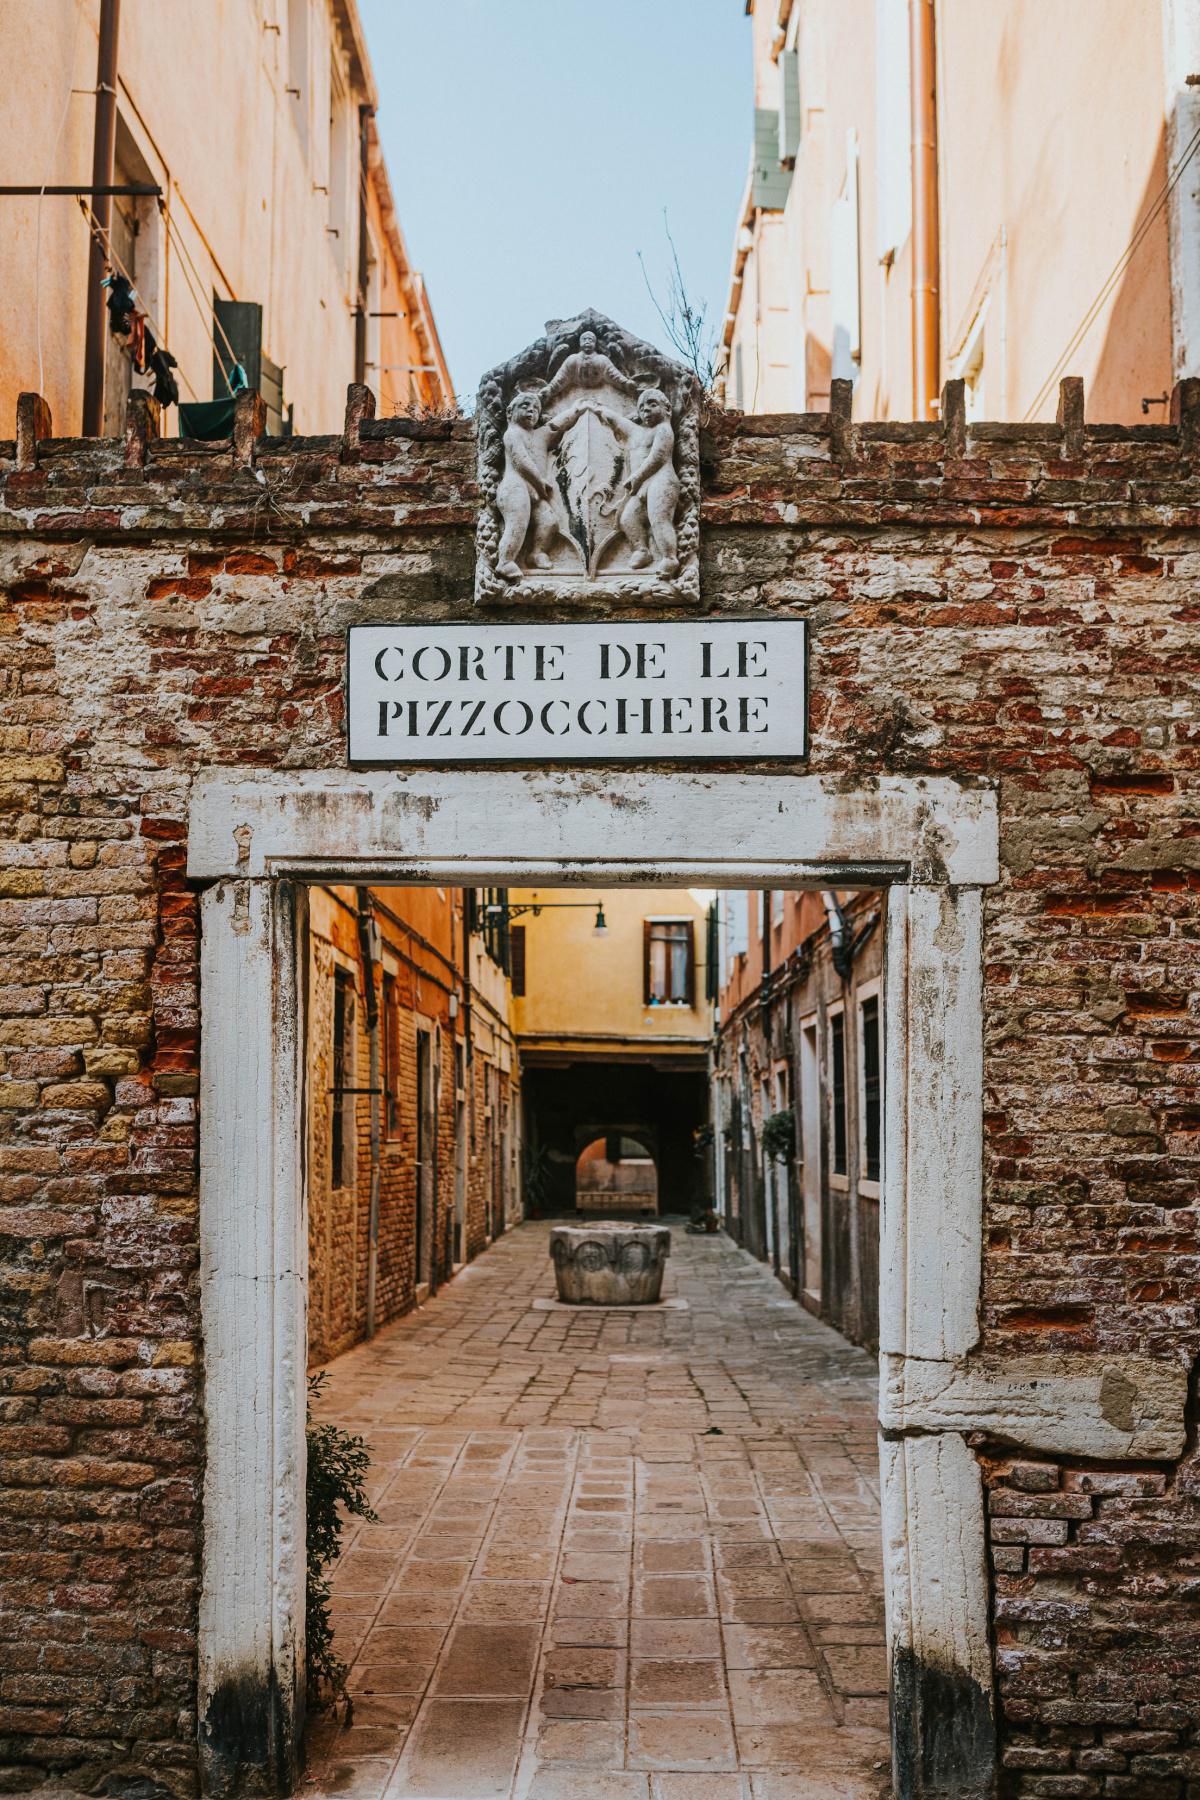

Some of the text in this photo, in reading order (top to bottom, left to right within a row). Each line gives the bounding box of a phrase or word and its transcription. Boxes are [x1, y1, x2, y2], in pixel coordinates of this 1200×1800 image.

[374, 641, 768, 682] CORTE DE LE
[376, 696, 769, 737] PIZZOCCHERE
